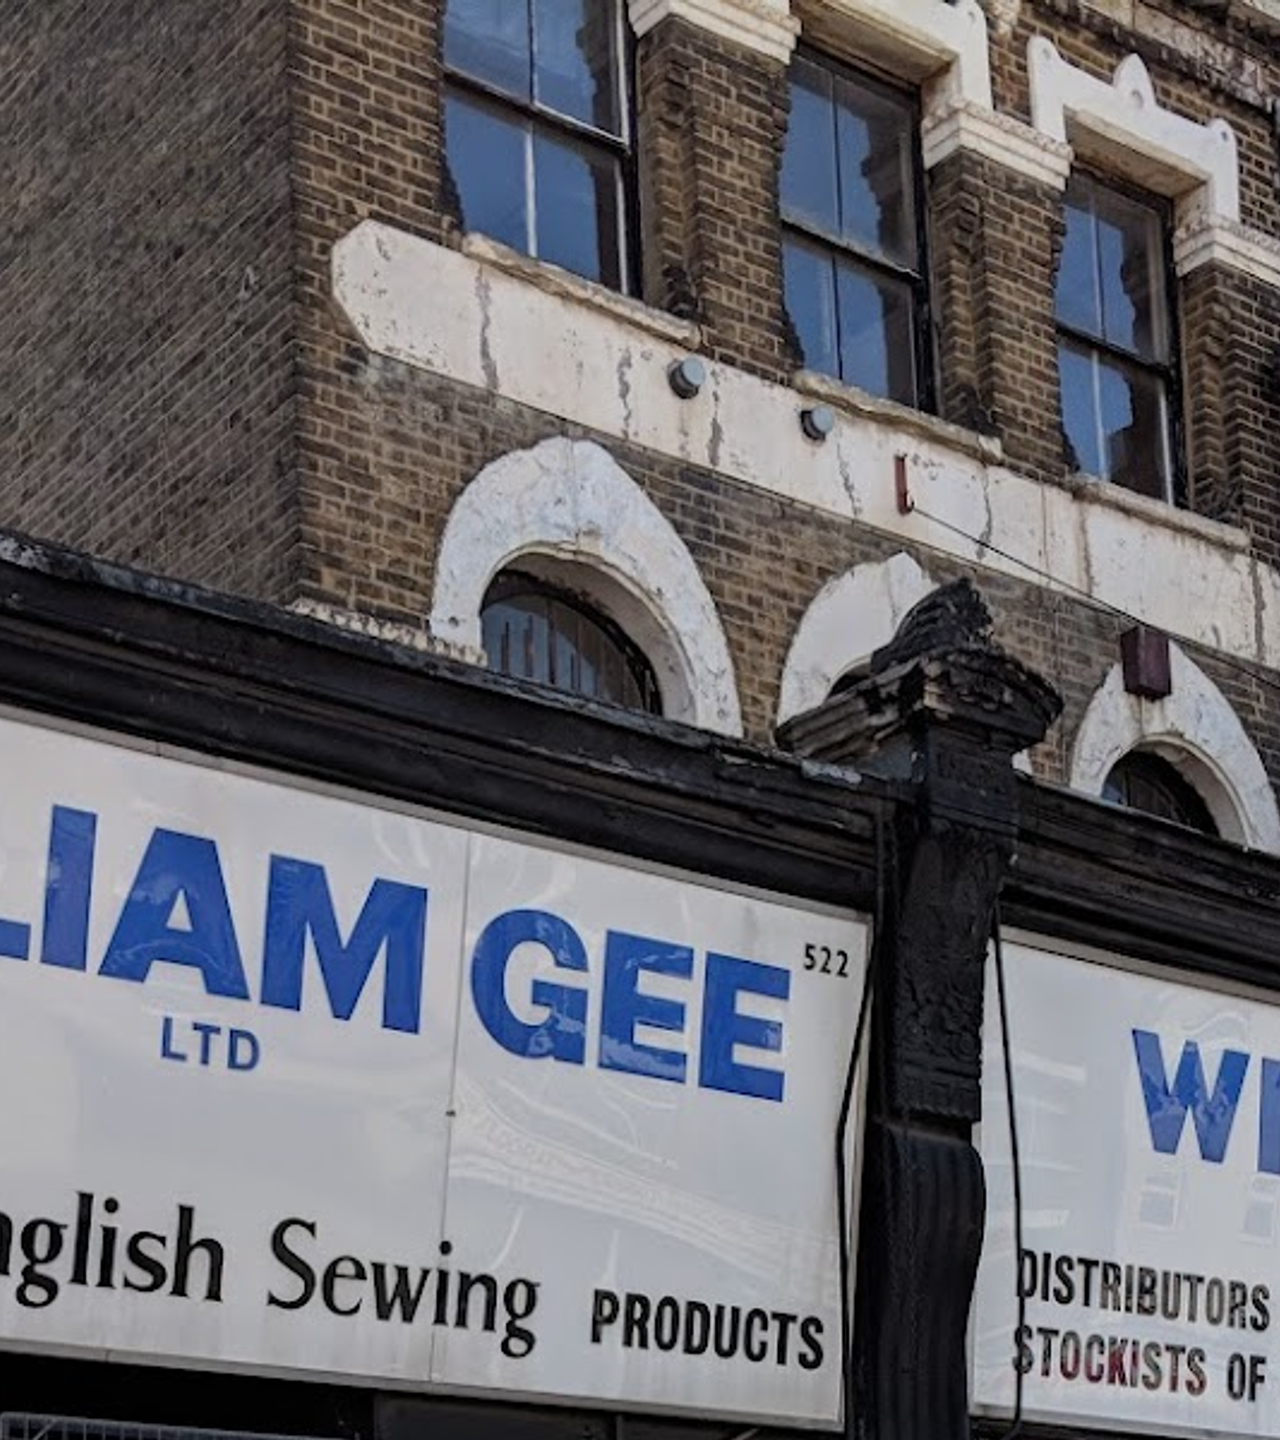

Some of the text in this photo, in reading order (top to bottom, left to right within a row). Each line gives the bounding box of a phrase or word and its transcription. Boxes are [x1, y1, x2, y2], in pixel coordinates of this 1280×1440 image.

[803, 942, 850, 979] 522
[160, 1016, 261, 1071] LTD
[470, 908, 792, 1103] GEE
[267, 1216, 542, 1359] Sewing
[589, 1289, 825, 1371] PRODUCTS
[1017, 1248, 1271, 1332] DISTRIBUTORS
[1013, 1325, 1208, 1396] STOCKISTS
[1226, 1352, 1267, 1402] OF
